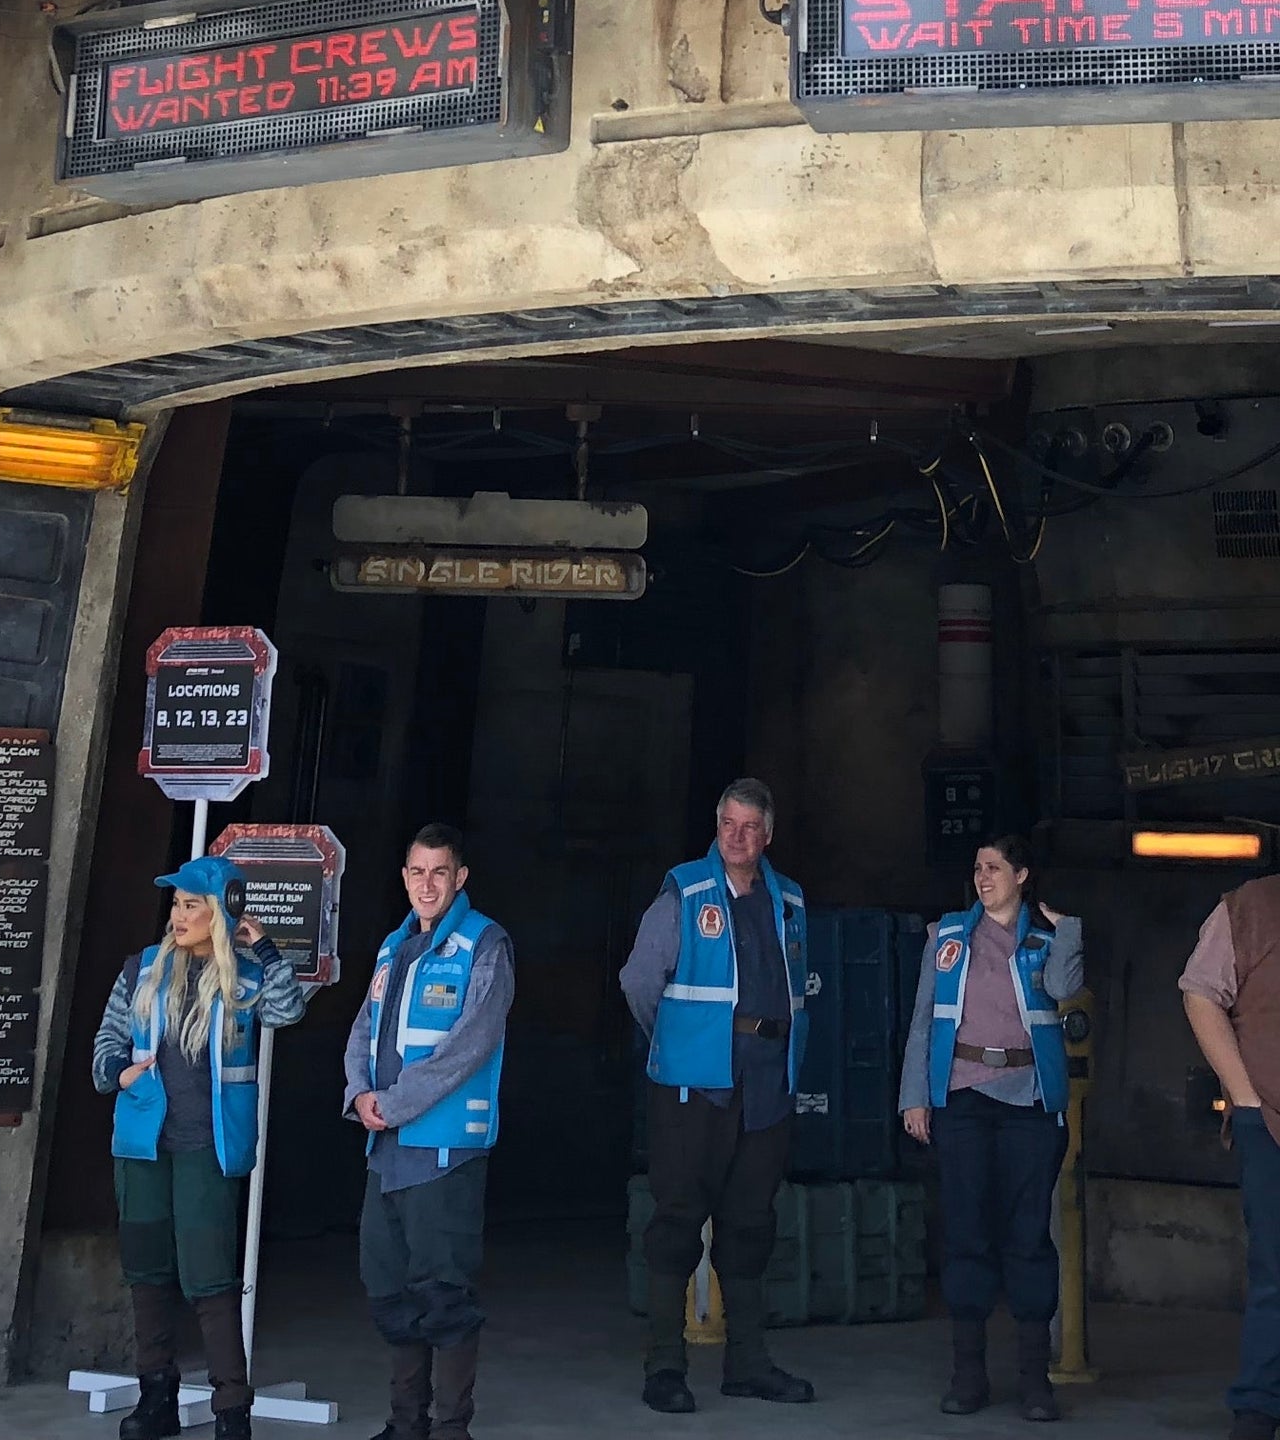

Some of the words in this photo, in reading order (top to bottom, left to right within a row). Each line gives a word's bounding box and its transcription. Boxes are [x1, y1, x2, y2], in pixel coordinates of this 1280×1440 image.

[856, 19, 993, 50] WAIT
[1009, 13, 1133, 45] TIME
[1153, 11, 1184, 39] 5
[109, 44, 279, 101] FLIGHT
[289, 15, 479, 74] CREWS
[110, 80, 296, 131] WANTED
[316, 71, 397, 103] 11:39
[408, 56, 478, 92] AM
[366, 560, 500, 583] SINGLE
[511, 560, 618, 586] RIDER
[168, 685, 240, 697] LOCATIONS
[157, 710, 170, 728] 8,
[176, 710, 195, 728] 12,
[200, 710, 220, 728] 13,
[226, 710, 247, 726] 23
[1125, 755, 1226, 785] FLIGHT
[3, 805, 35, 813] CREW
[6, 813, 19, 821] BE
[941, 819, 963, 834] 23
[4, 848, 42, 856] ROUTE.
[286, 894, 303, 902] RUN
[245, 904, 293, 913] ATTRACTION
[254, 915, 278, 924] HESS
[280, 916, 303, 925] ROOM
